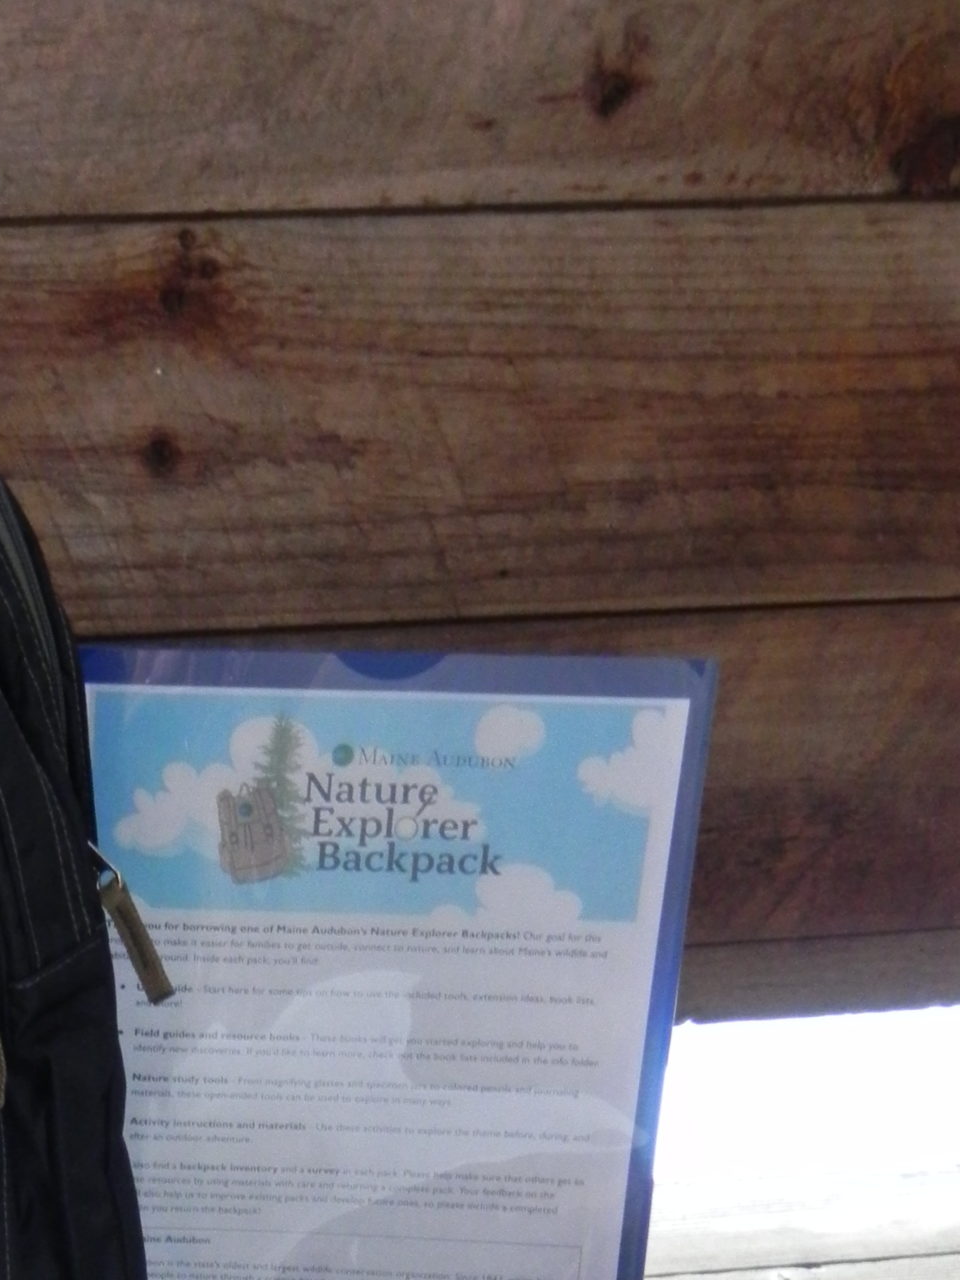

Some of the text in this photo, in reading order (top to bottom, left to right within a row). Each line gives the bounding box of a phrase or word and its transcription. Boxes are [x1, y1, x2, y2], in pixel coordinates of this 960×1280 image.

[305, 772, 439, 806] Nature
[311, 805, 478, 847] Explorer
[316, 841, 503, 881] Backpack
[164, 922, 179, 930] for
[183, 922, 236, 934] borrowing
[277, 925, 307, 933] Maine
[311, 925, 366, 935] Audubon's
[371, 927, 407, 936] Nature
[412, 928, 457, 939] Explorer
[134, 1028, 159, 1037] Field
[163, 1029, 195, 1040] guides
[199, 1030, 217, 1039] and
[221, 1033, 266, 1041] resource
[269, 1033, 299, 1042] books
[132, 1072, 228, 1085] Nature study tools
[130, 1116, 305, 1131] Activity instructions and materials
[179, 1160, 339, 1178] backpack inventory survey
[165, 1234, 210, 1244] Audubon
